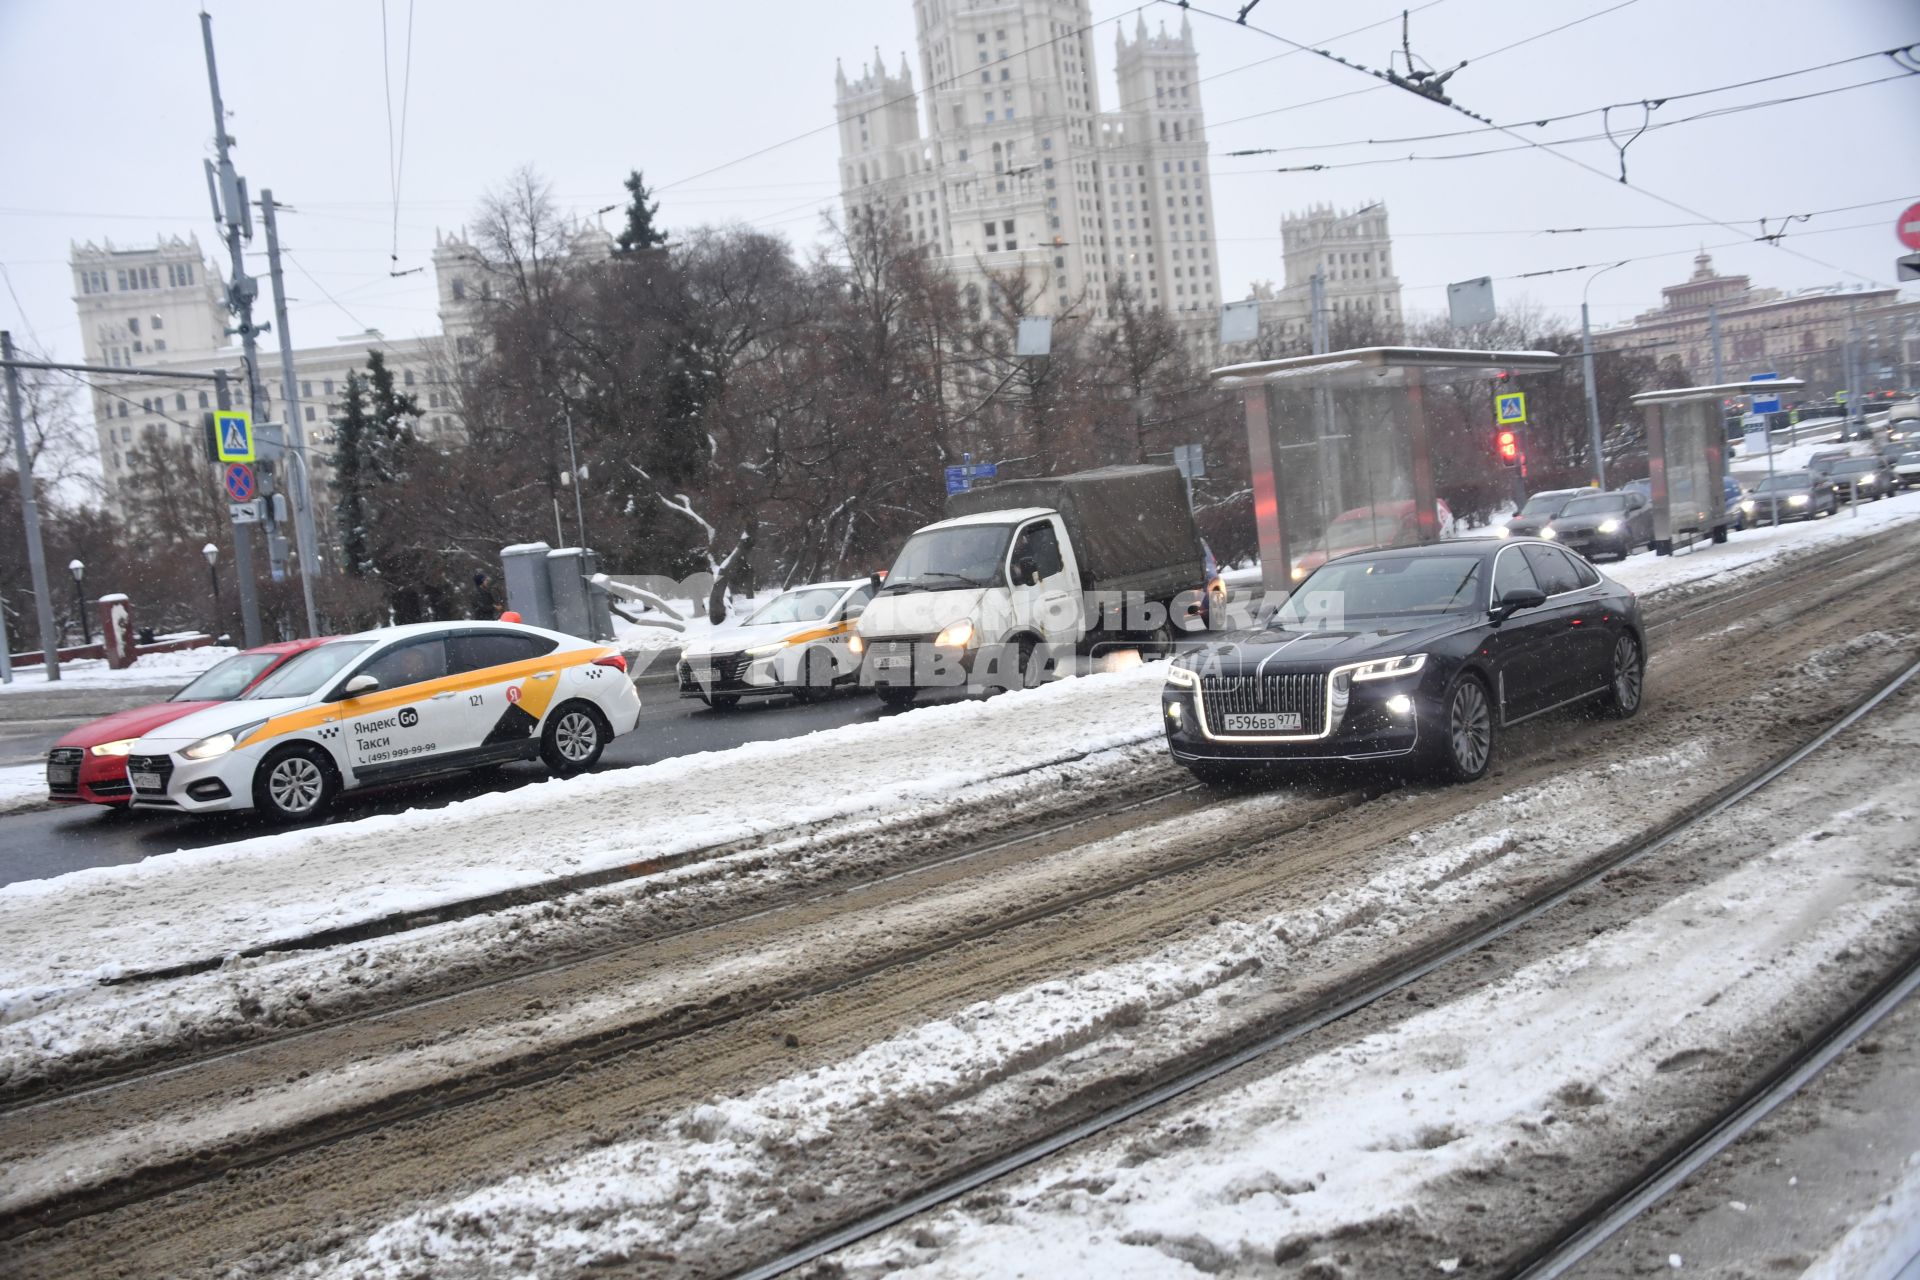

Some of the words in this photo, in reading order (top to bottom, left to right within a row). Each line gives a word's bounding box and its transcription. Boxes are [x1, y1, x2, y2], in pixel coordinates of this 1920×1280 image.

[469, 695, 483, 707] 121
[354, 716, 396, 734] Яндекс
[400, 712, 417, 724] Go
[1277, 714, 1297, 724] 977
[357, 737, 390, 751] Такси
[368, 752, 390, 764] (495)
[392, 743, 436, 758] 999-99-99
